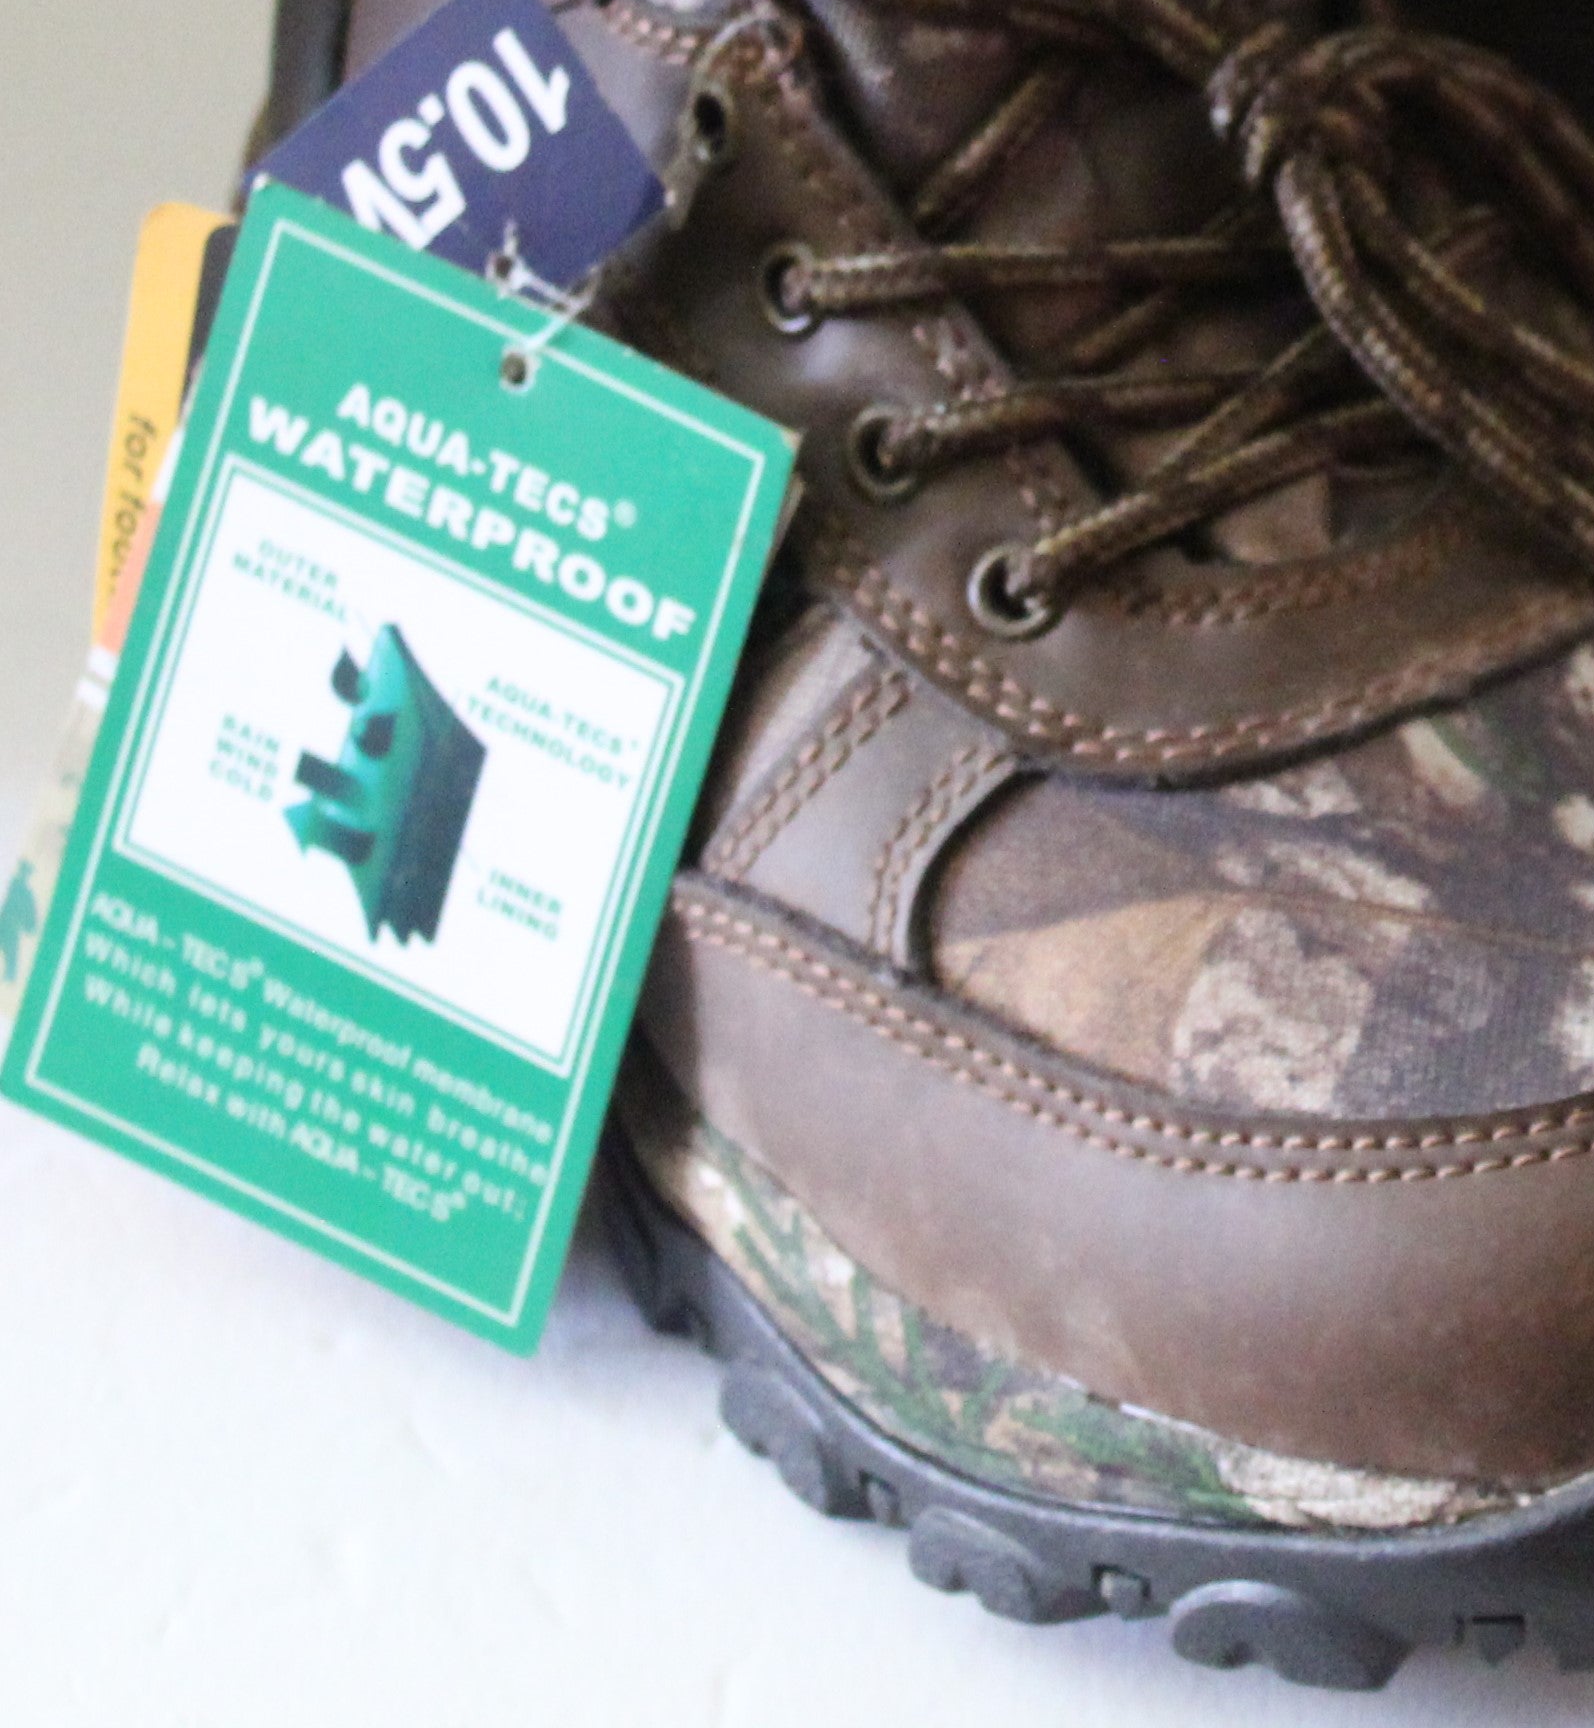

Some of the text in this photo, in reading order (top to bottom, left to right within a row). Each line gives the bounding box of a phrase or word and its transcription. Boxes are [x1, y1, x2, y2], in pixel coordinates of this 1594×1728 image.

[248, 395, 697, 641] WATERPROOF
[232, 551, 347, 623] MATERIAL
[258, 539, 338, 589] OUTER
[222, 713, 281, 755] RAIN
[467, 695, 630, 789] TECHNOLOGY
[209, 758, 274, 803] COLD
[476, 886, 558, 942] LINING
[489, 870, 563, 915] INNER
[84, 931, 549, 1187] Which lets yours skin breathe
[84, 973, 173, 1039] While
[177, 1021, 304, 1111] keeping
[310, 1089, 361, 1134] the
[368, 1123, 457, 1182] water
[136, 1042, 220, 1106] Relax
[225, 1094, 287, 1140] with
[263, 978, 412, 1070] Waterproof
[412, 1057, 553, 1145] membrane
